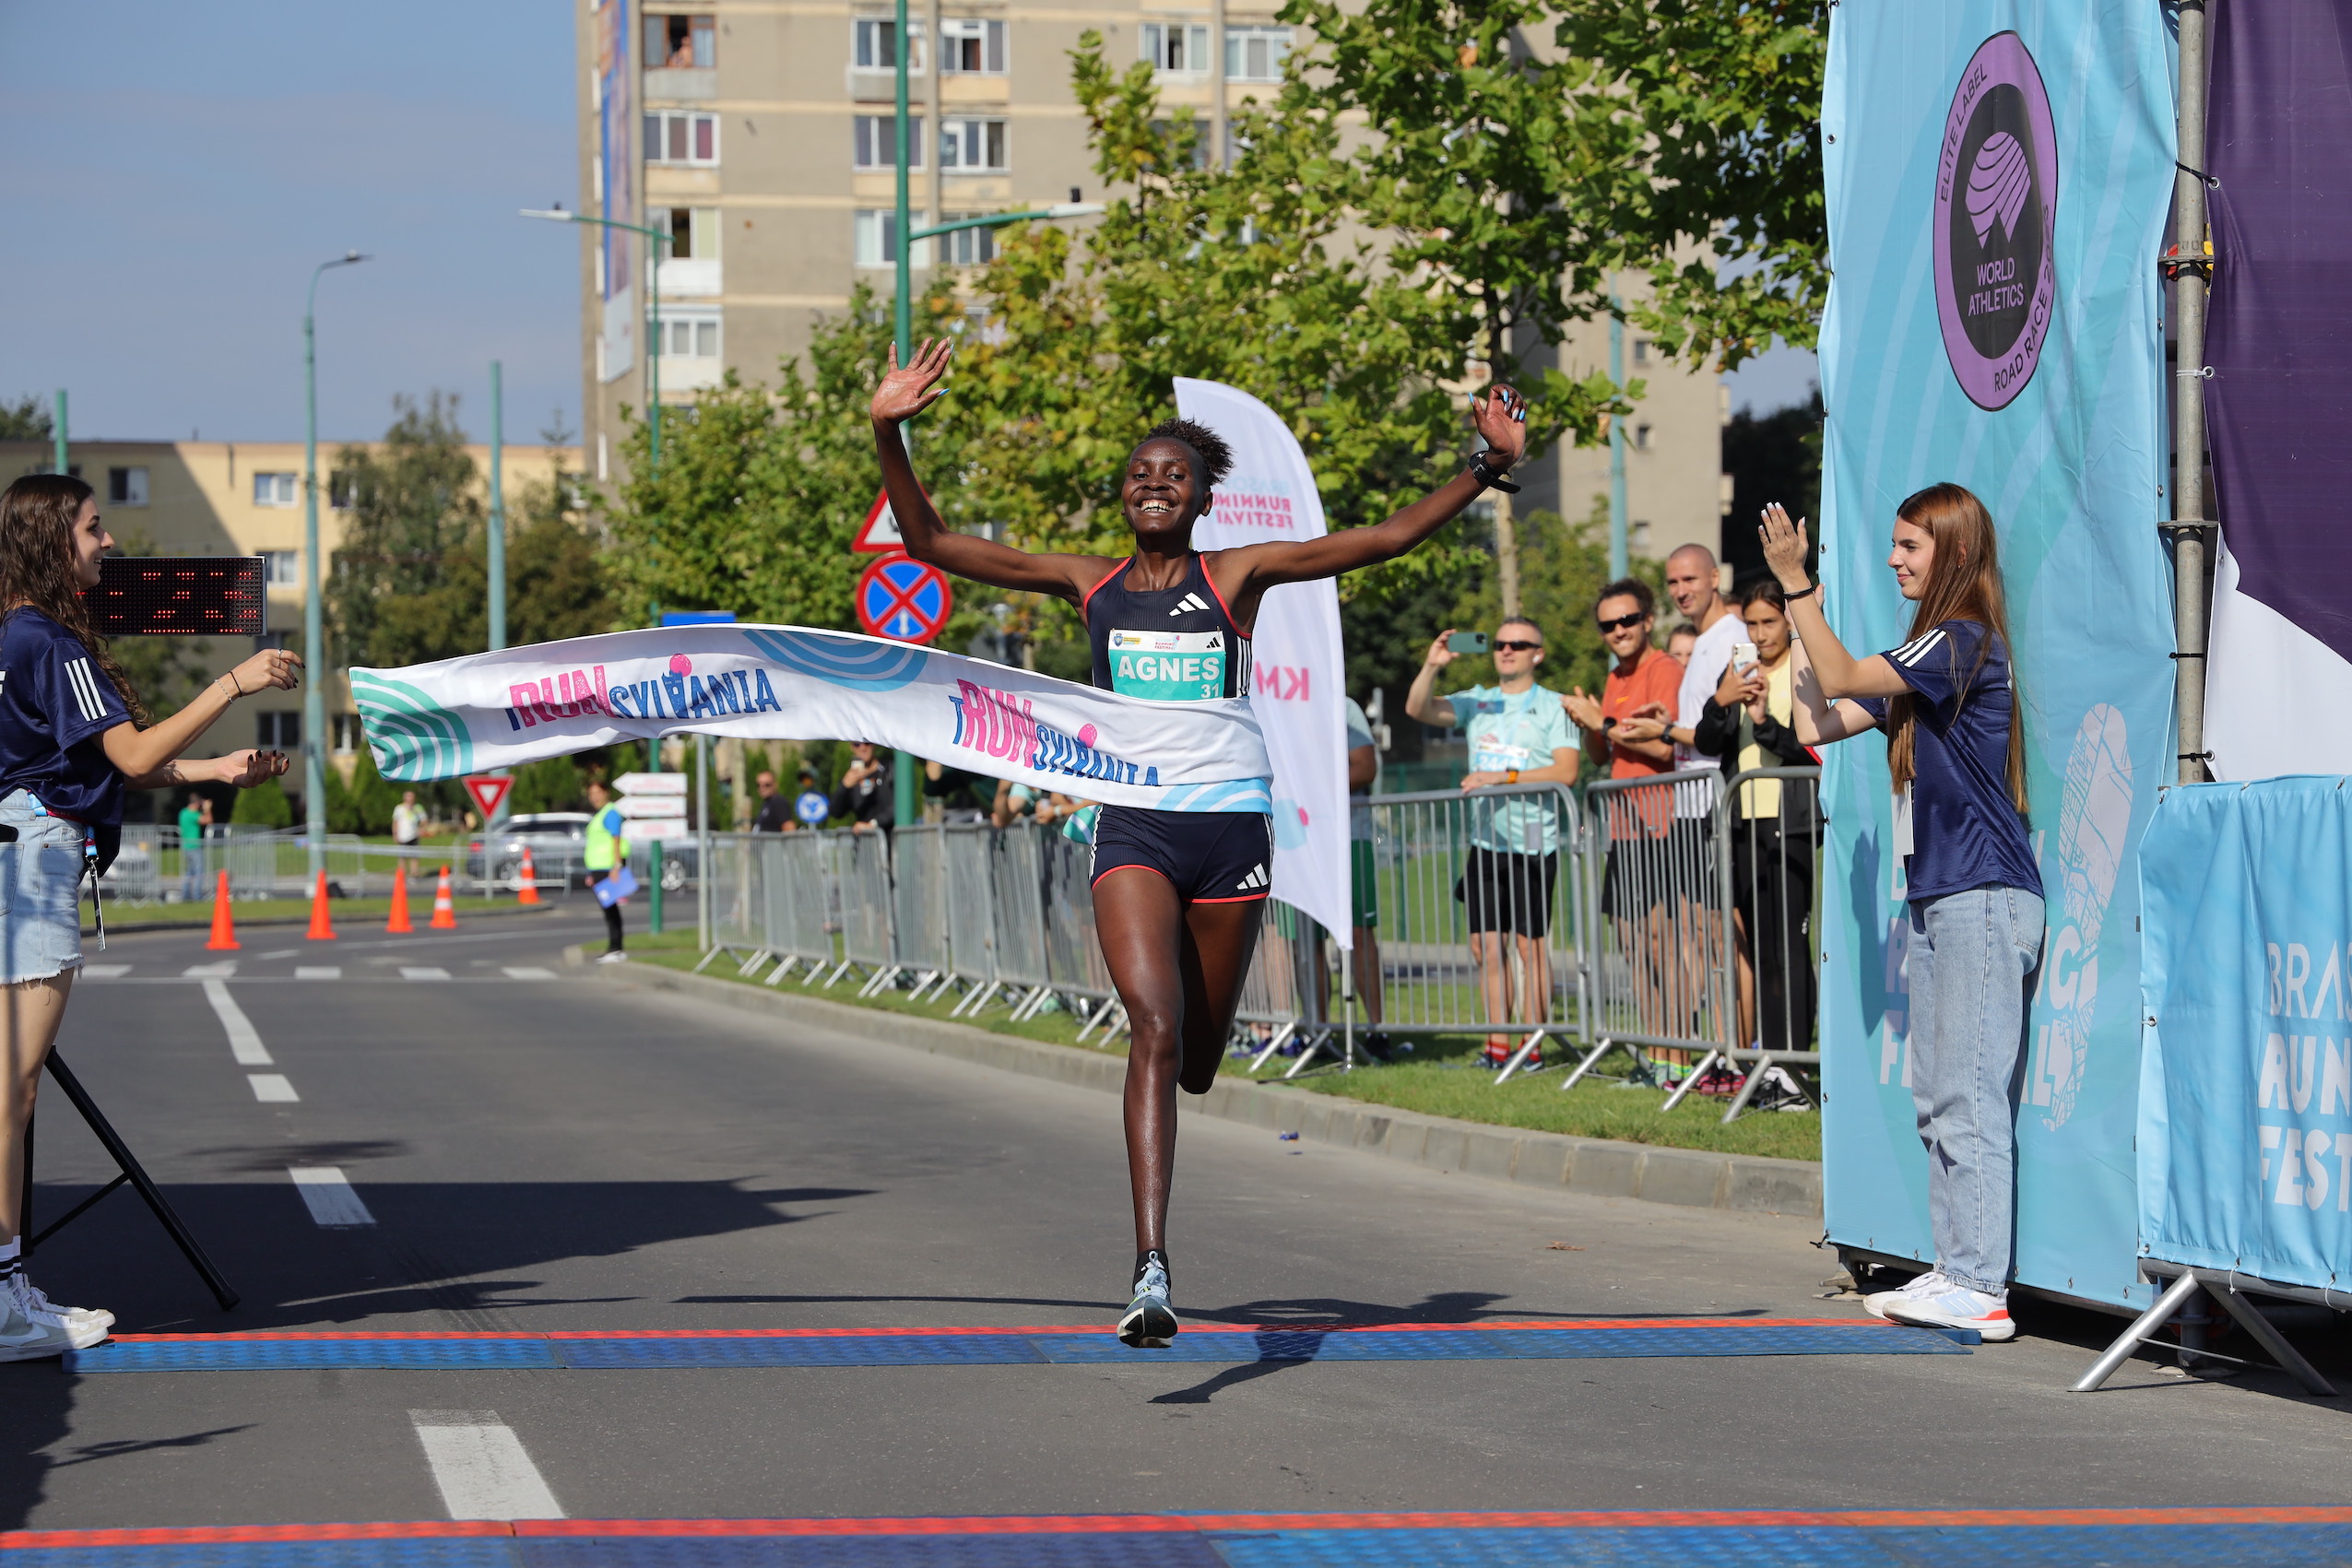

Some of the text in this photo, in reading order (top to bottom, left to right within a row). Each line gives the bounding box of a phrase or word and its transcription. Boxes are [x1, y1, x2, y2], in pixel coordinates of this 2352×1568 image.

[1940, 63, 1988, 203] ELITE LABEL
[1976, 256, 2015, 287] WORLD
[1968, 282, 2025, 317] ATHLETICS
[1994, 353, 2024, 393] ROAD
[2023, 289, 2048, 360] RACE
[1117, 655, 1220, 681] AGNES
[1200, 683, 1219, 699] 31
